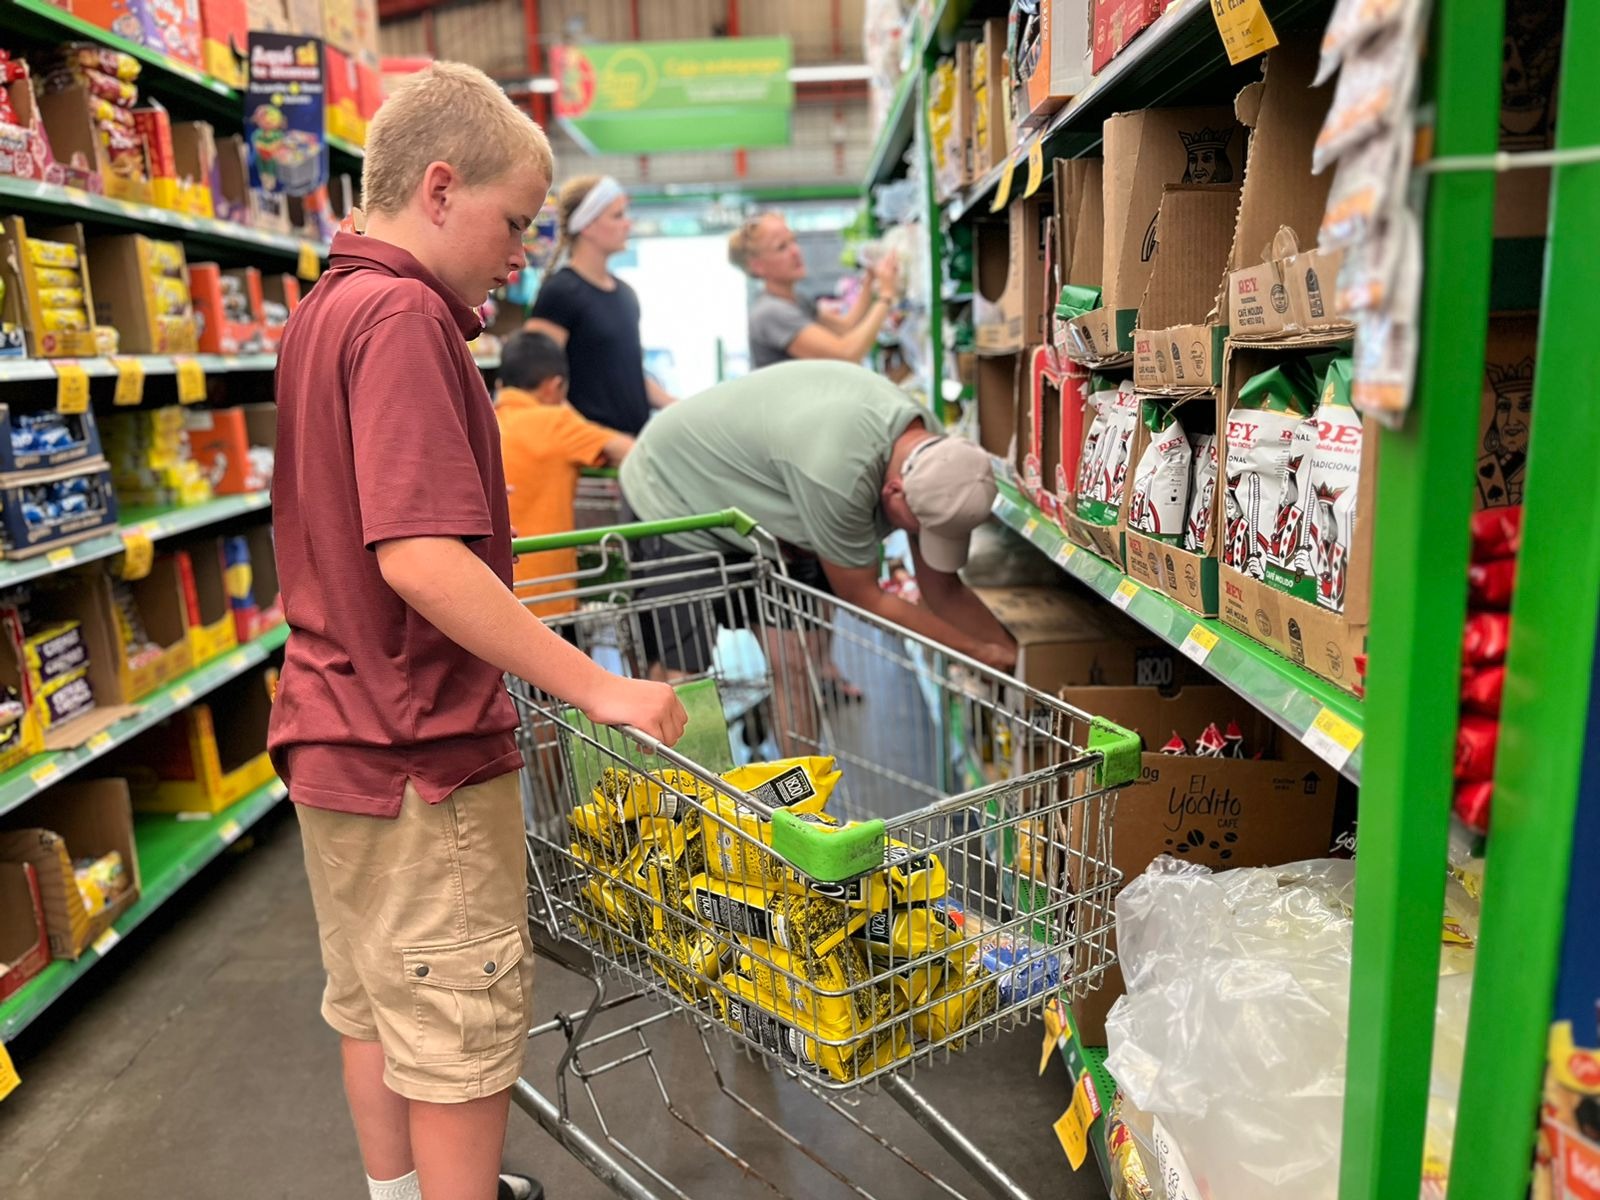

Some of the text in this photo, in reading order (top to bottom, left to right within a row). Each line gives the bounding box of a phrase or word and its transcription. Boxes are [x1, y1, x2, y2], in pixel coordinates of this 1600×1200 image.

[1238, 278, 1259, 294] REY
[1226, 421, 1259, 441] EY
[1318, 421, 1363, 445] RE
[1158, 436, 1184, 452] REY
[1225, 580, 1244, 603] REY
[1274, 575, 1294, 588] MOLIDO
[1137, 656, 1172, 685] 1820
[785, 776, 804, 797] 1820
[1188, 774, 1206, 794] El
[871, 913, 887, 935] 1820
